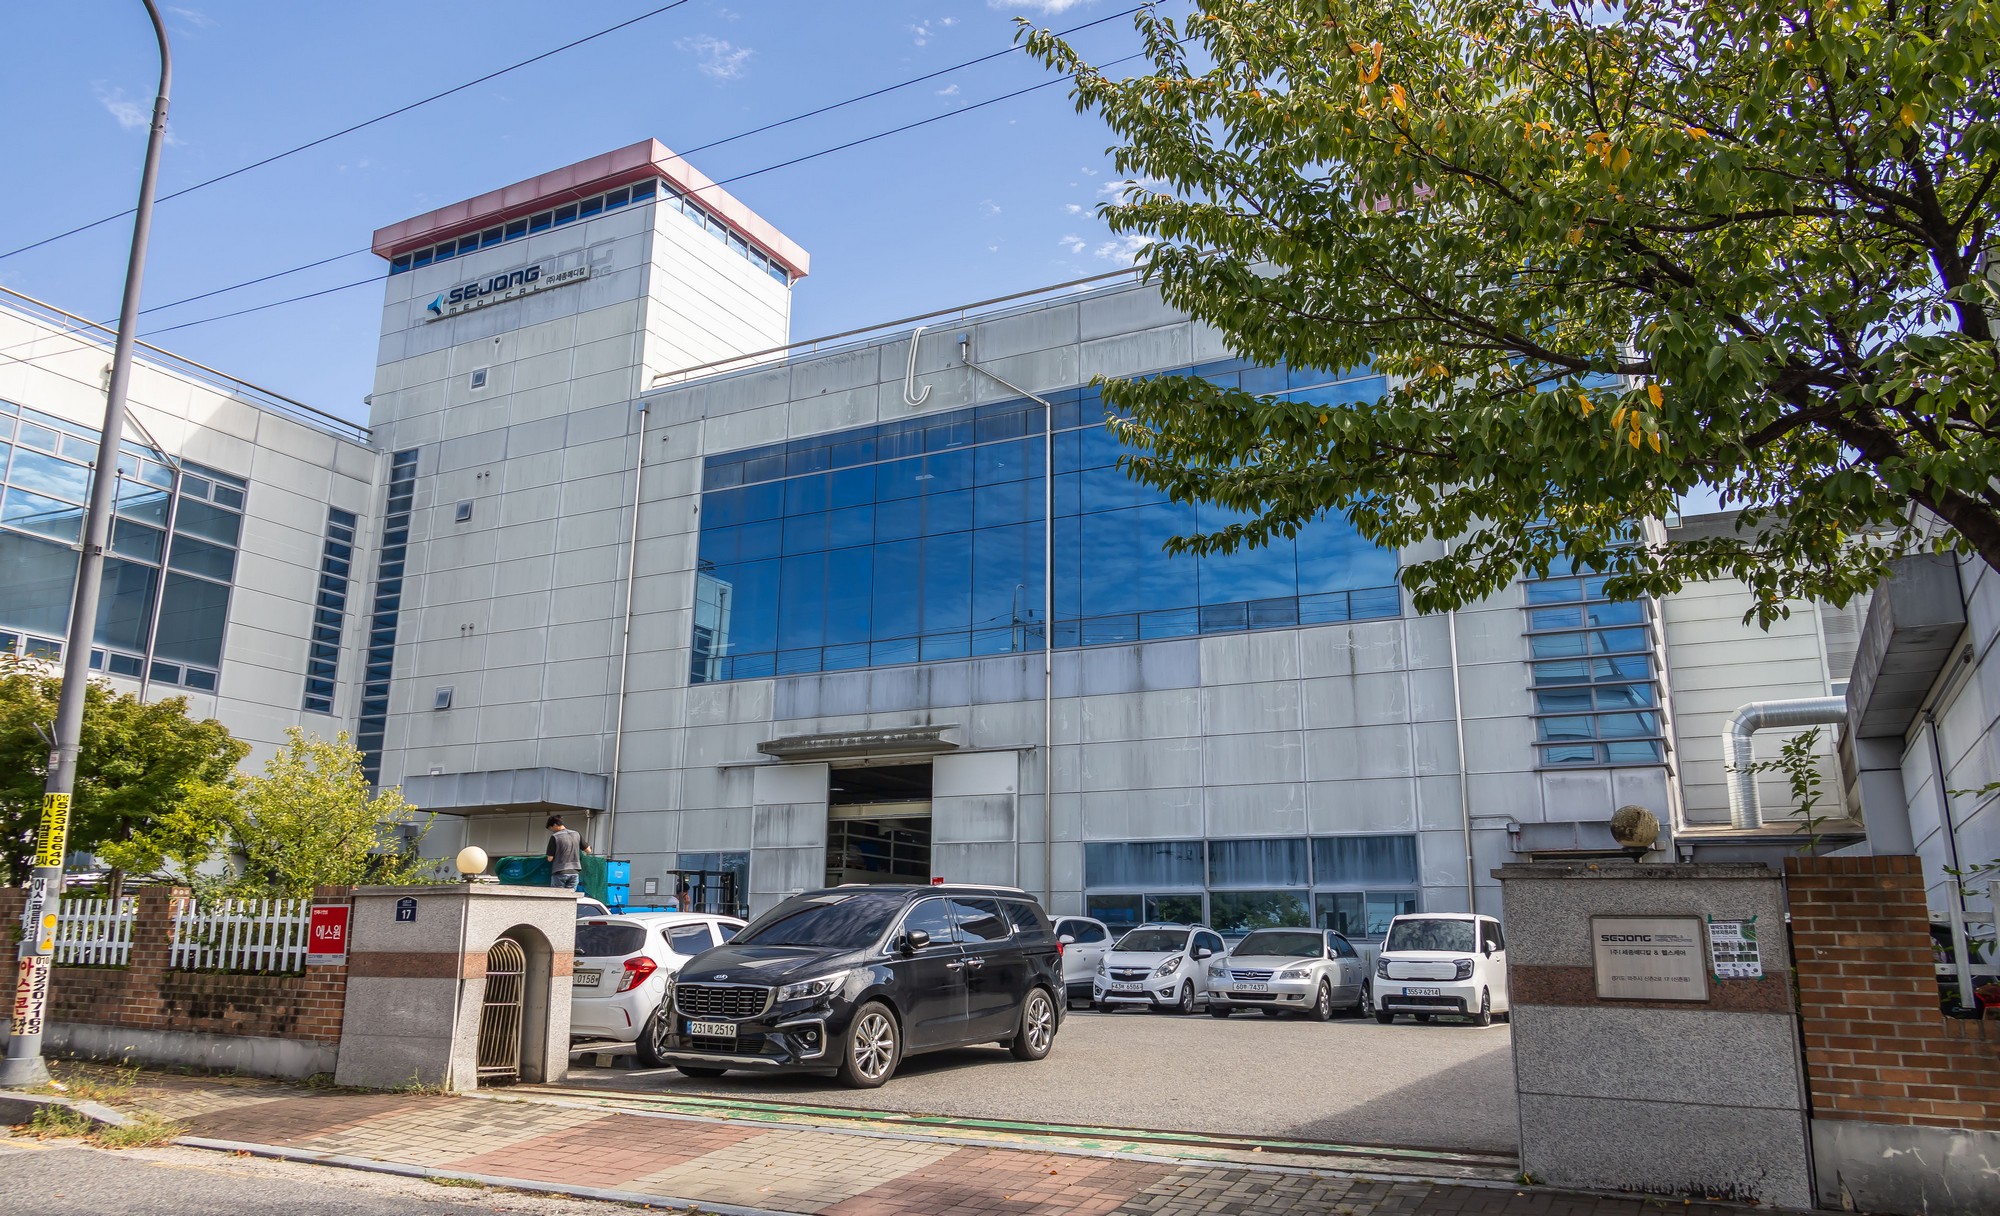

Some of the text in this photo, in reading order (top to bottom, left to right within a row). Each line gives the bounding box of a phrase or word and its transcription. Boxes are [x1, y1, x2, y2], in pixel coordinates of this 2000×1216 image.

[449, 265, 542, 304] SEJONG
[450, 285, 540, 315] MEDICAL
[401, 910, 412, 919] 17
[315, 925, 342, 940] 에스원
[1601, 934, 1651, 942] SEJONG
[714, 1024, 735, 1036] 2519
